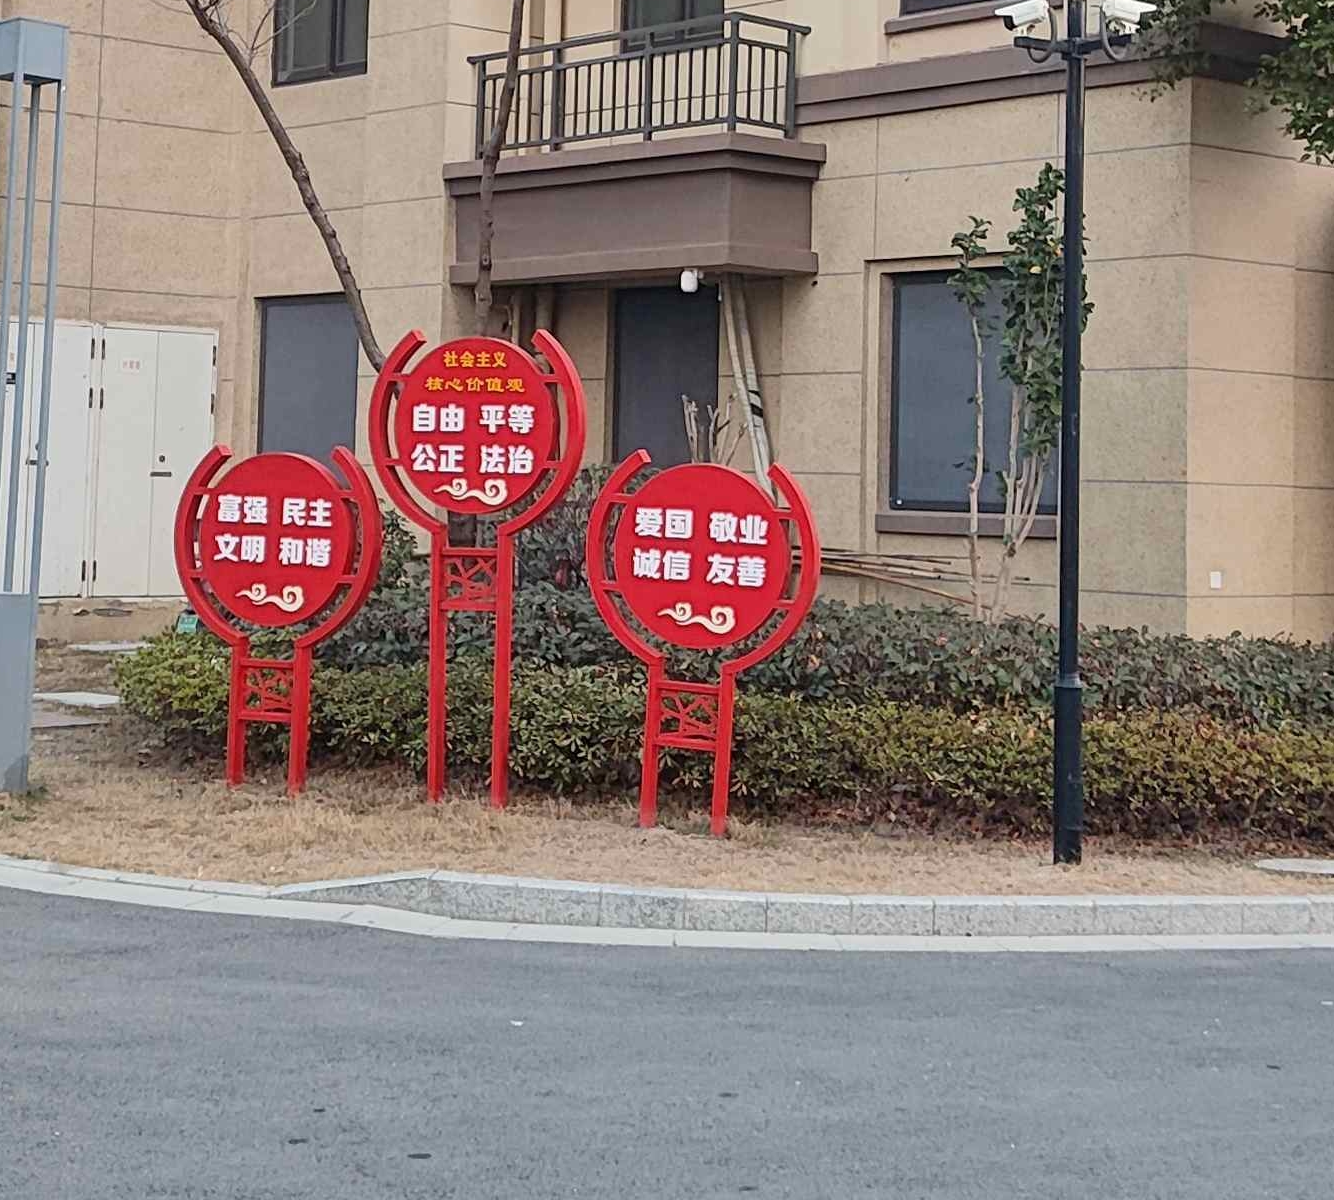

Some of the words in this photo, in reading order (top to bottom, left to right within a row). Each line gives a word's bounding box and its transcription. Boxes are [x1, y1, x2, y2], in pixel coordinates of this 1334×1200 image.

[443, 351, 507, 368] 社会主义
[425, 376, 525, 393] 核心价值观
[412, 403, 465, 432] 自由
[479, 404, 535, 434] 平等
[411, 443, 465, 473] 公正
[479, 445, 534, 474] 法治
[217, 494, 268, 524] 富强
[282, 497, 332, 527] 民主
[634, 507, 693, 539] 爱国
[709, 511, 768, 545] 敬业
[213, 533, 265, 563] 文明
[278, 537, 331, 567] 和谐
[632, 547, 692, 581] 诚信
[706, 553, 766, 587] 友善
